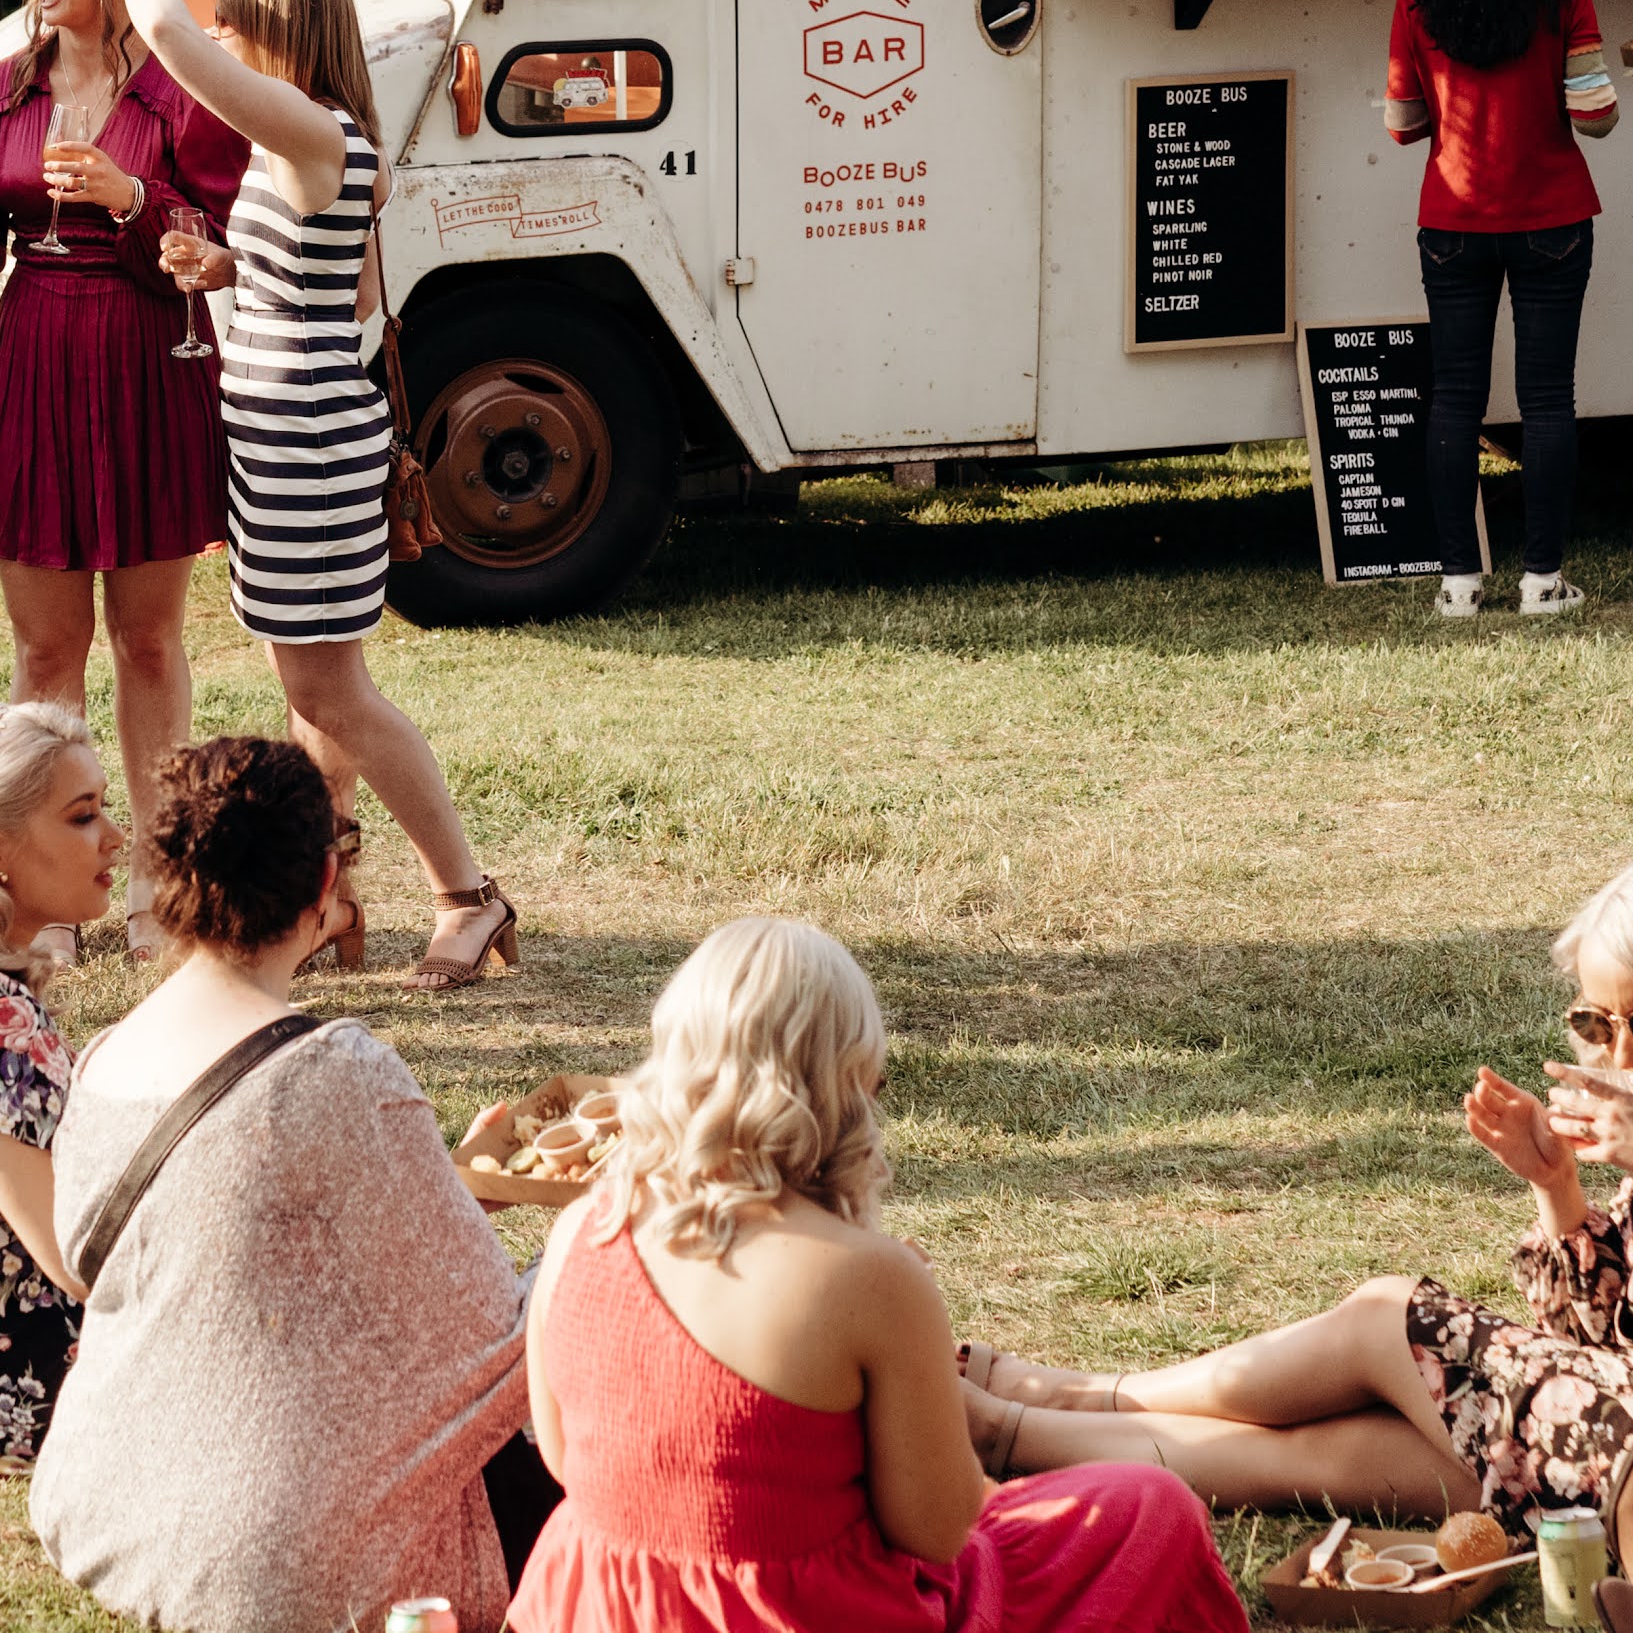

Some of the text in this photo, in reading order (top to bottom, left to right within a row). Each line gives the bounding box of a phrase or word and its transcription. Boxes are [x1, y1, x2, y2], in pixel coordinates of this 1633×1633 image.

[823, 38, 906, 65] BAR
[1166, 87, 1248, 105] BOOZE BUS
[805, 87, 917, 129] FOR HIRE
[1148, 122, 1186, 138] BEER
[1156, 140, 1231, 154] STONE & WOOD
[659, 150, 697, 175] 41
[1155, 156, 1235, 171] CASCADE LAGER
[804, 161, 927, 187] BOOZE BUS
[1156, 174, 1198, 187] FAT YAK
[805, 195, 925, 213] 0478 801 049
[1147, 199, 1195, 216] WINES
[443, 202, 514, 223] LET THE GOOD
[520, 212, 589, 230] TIMES ROLL
[1152, 221, 1207, 235] SPARKLING
[1152, 238, 1188, 251] WHITE
[1152, 252, 1222, 267] CHILLED RED
[1152, 269, 1213, 283] PINOT NOIR
[1145, 295, 1199, 312] SELTZER
[1334, 330, 1414, 348] BOOZE BUS
[1318, 366, 1379, 384] COCKTAILS
[1333, 403, 1372, 415] PALOMA
[1334, 413, 1414, 427] TROPICAL THUNDA
[1348, 427, 1399, 440] VODKA GIN
[1330, 453, 1375, 469] SPIRITS
[1338, 473, 1374, 485] CAPTAIN
[1340, 485, 1382, 498] JAMESON
[1341, 500, 1353, 510] 40
[1391, 497, 1405, 507] GIN
[1341, 511, 1377, 523] TEQUILA
[1343, 523, 1388, 536] FIREBALL
